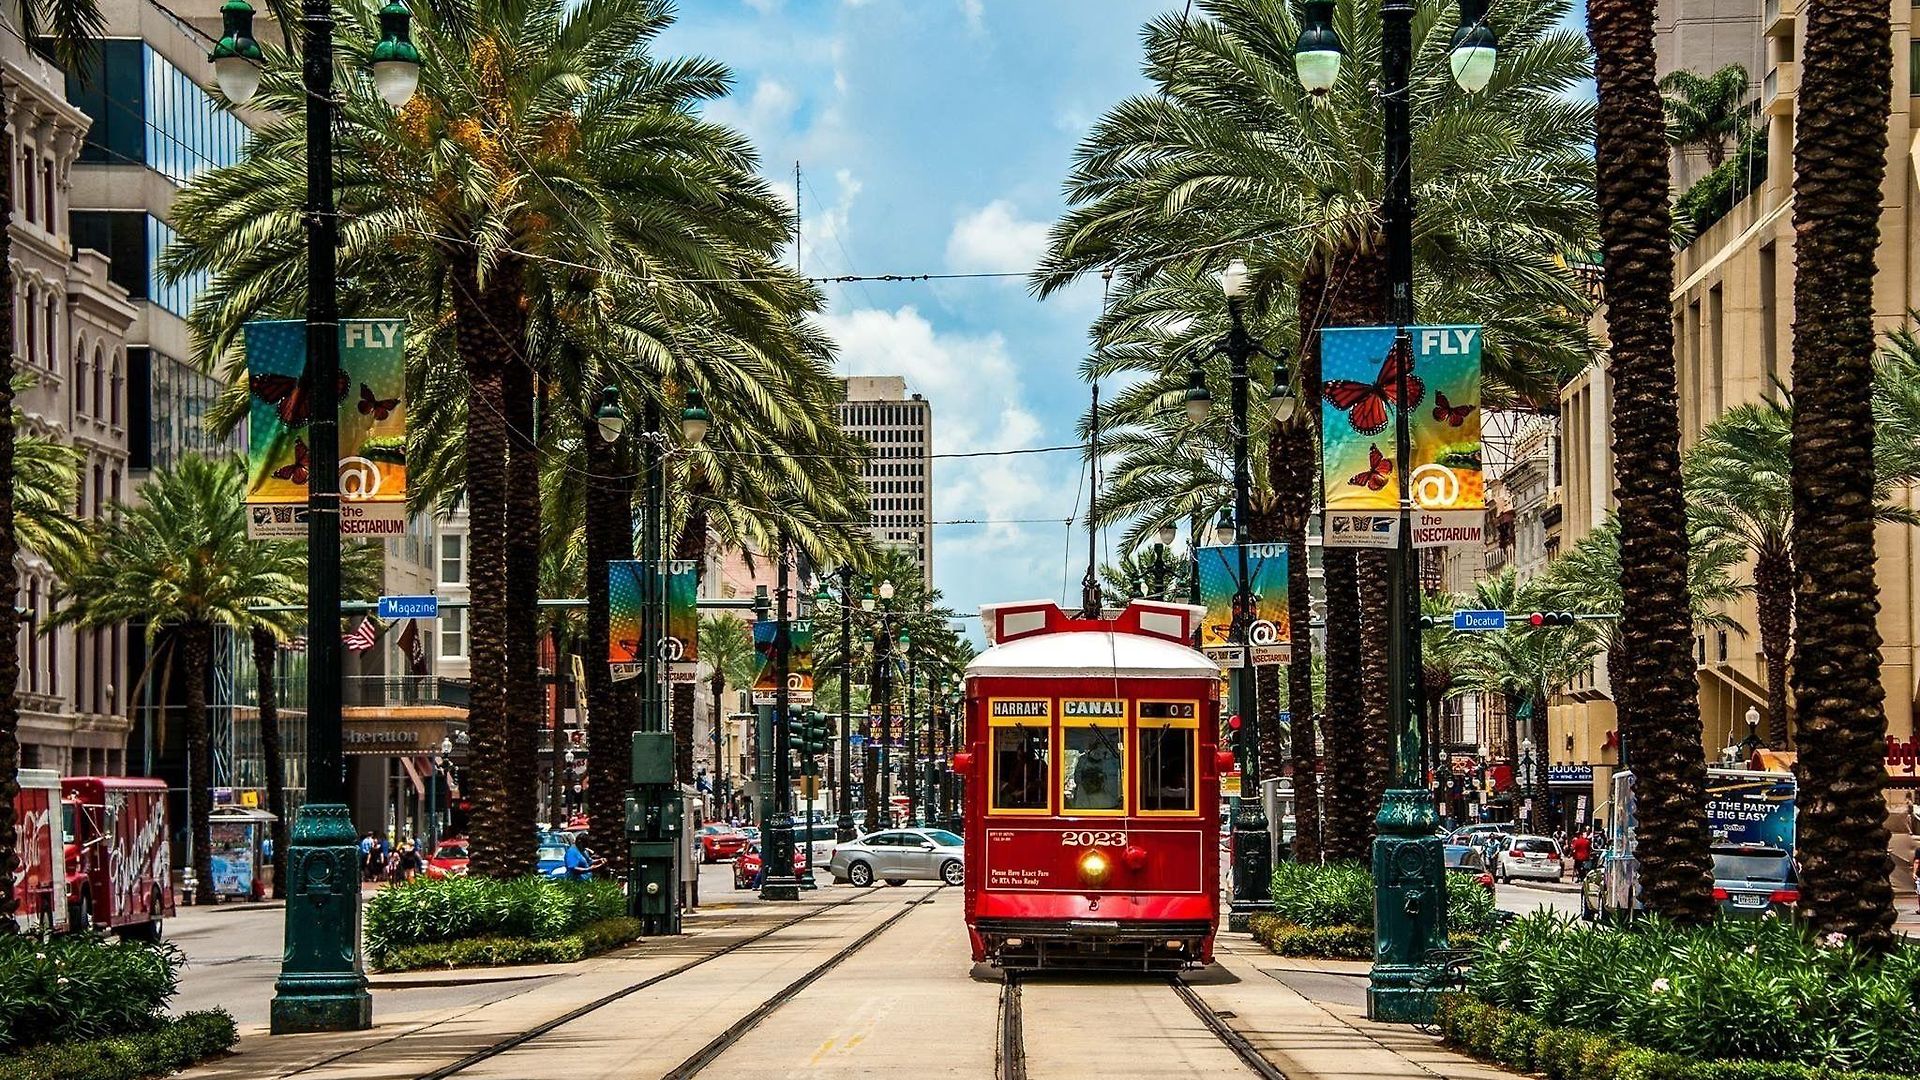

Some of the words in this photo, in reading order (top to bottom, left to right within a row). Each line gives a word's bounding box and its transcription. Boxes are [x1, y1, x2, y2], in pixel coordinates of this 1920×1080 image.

[345, 323, 399, 347] FLY
[1421, 329, 1477, 355] FLY
[342, 506, 363, 517] the
[1421, 514, 1442, 526] the
[339, 520, 404, 534] NSECTARIUM
[1413, 527, 1481, 543] INSECTARIUM
[1249, 545, 1287, 559] HOP
[388, 600, 435, 616] Magazine
[1465, 614, 1500, 626] Decatur
[790, 621, 811, 632] FLY
[1253, 654, 1290, 663] NSECTARIUM
[994, 701, 1048, 715] HARRAH'S
[1064, 701, 1123, 714] CANAL
[1718, 801, 1741, 811] THE
[1743, 803, 1780, 813] PARTY
[1705, 810, 1714, 819] E
[1717, 811, 1735, 820] BIG
[1739, 812, 1768, 822] EASY
[1062, 831, 1127, 846] 2023
[1021, 869, 1037, 877] Exact
[991, 876, 998, 884] Or
[1023, 877, 1039, 887] Ready
